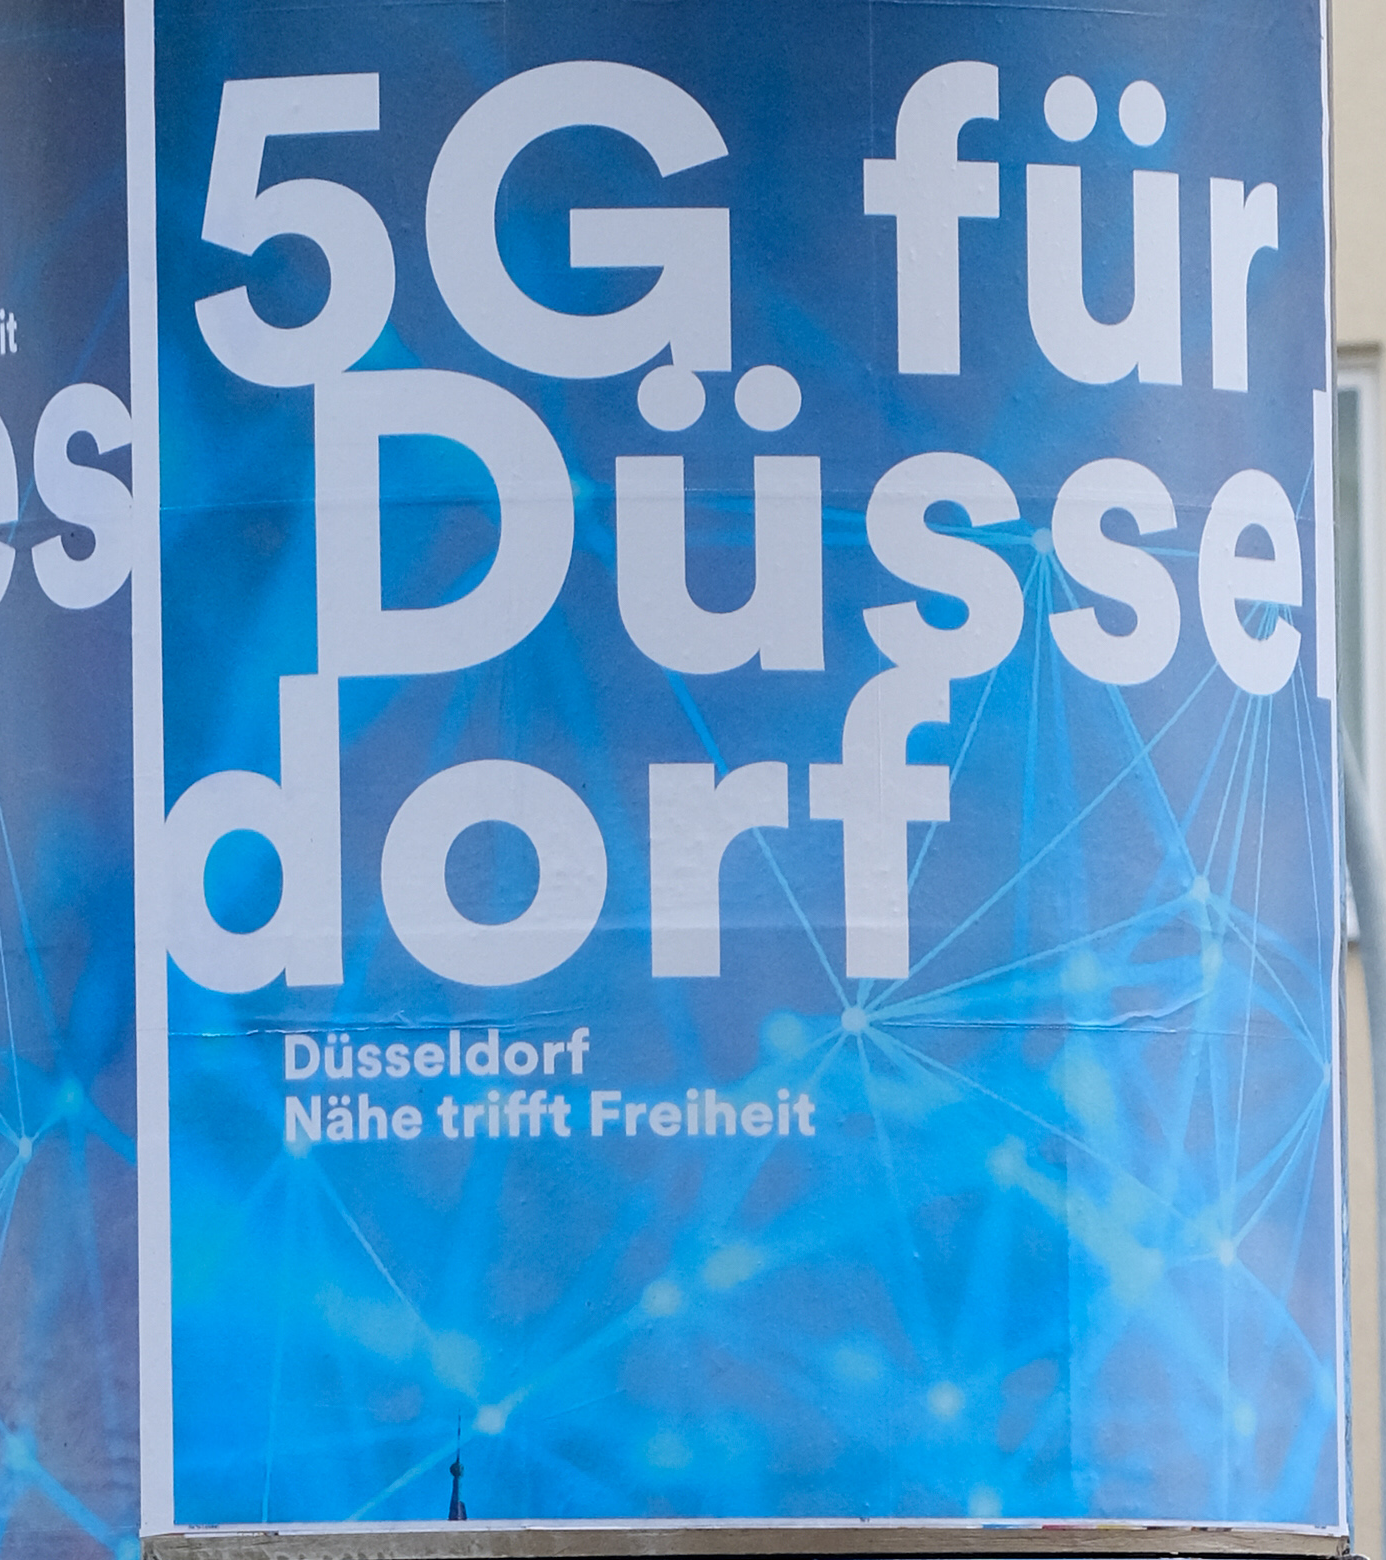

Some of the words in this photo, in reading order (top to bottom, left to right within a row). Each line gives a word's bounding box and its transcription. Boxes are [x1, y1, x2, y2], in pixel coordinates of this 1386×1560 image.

[194, 60, 731, 387] 5G
[863, 60, 1279, 391] für
[164, 662, 951, 993] dorf
[284, 1027, 591, 1081] Düsseldorf
[284, 1093, 423, 1142] Nähe
[437, 1089, 573, 1138] trifft
[590, 1088, 816, 1138] Freiheit
